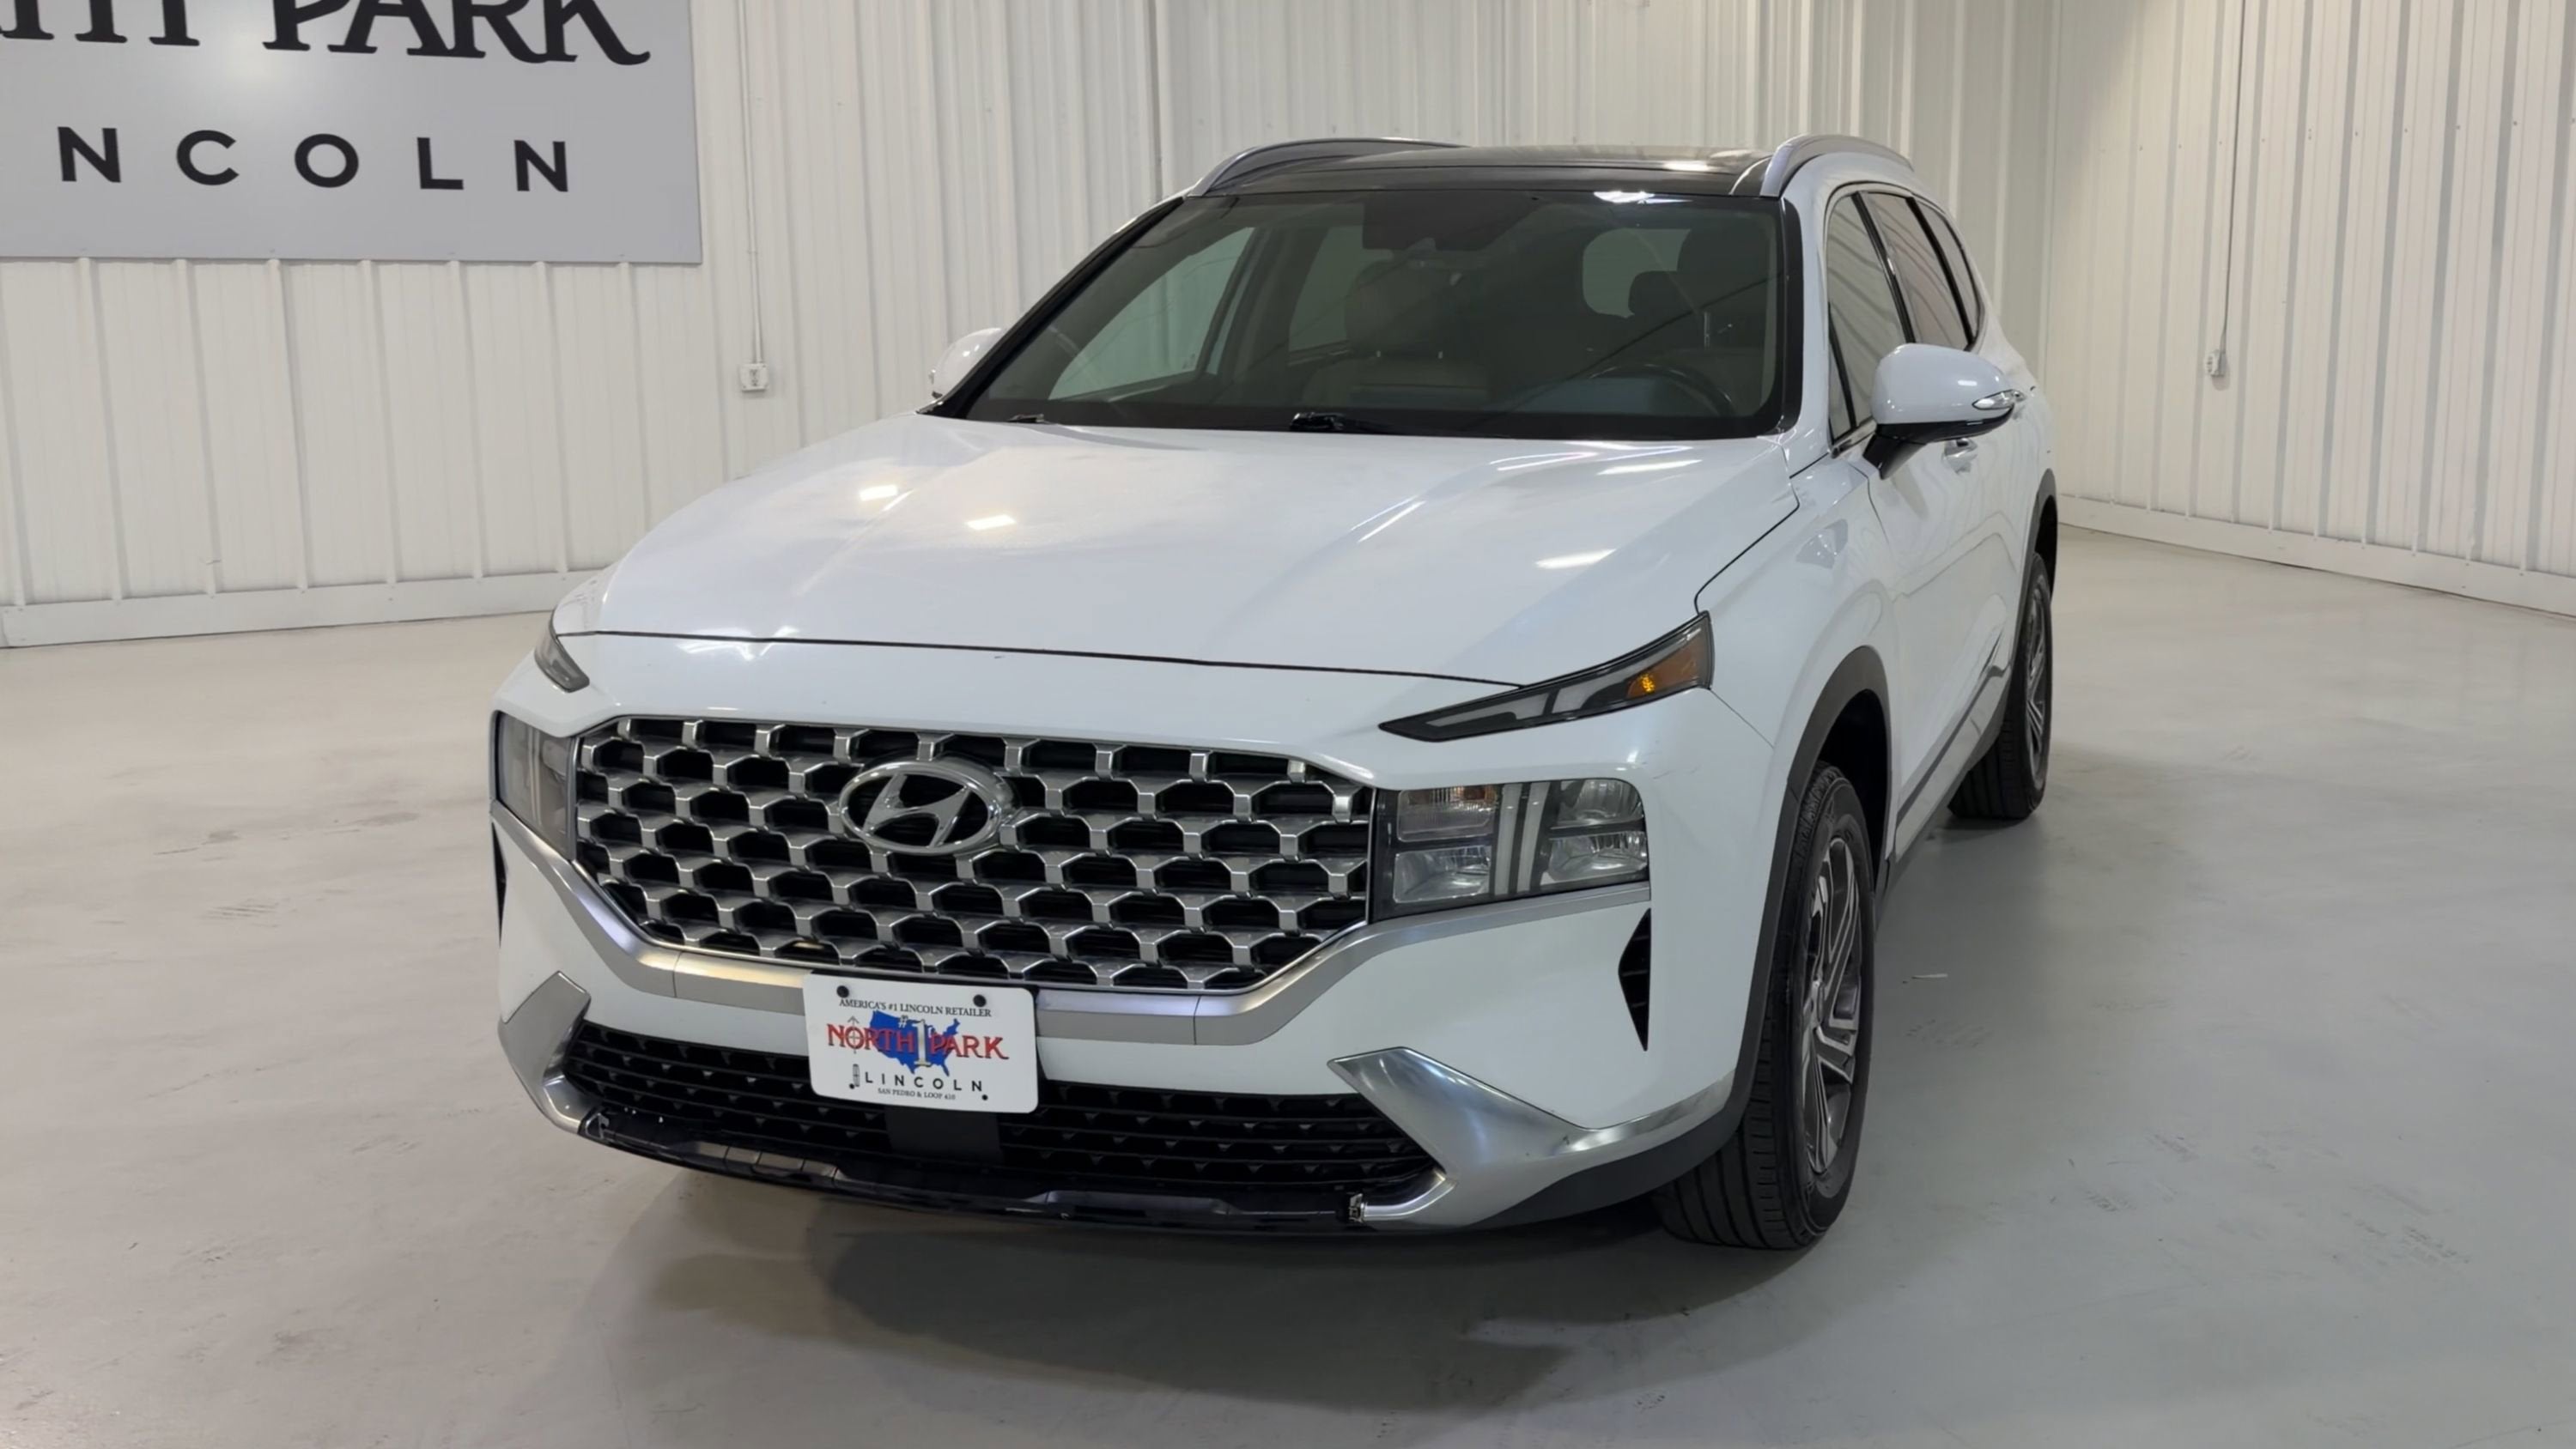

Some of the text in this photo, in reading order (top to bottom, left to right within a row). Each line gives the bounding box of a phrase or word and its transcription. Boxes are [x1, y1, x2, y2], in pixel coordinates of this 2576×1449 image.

[839, 998, 992, 1017] AMERICA'S #1 LINCOLN RETAILER
[827, 1023, 1010, 1060] NORTH PARK
[865, 1071, 982, 1092] LINCOLN
[892, 1088, 915, 1097] PEDRO
